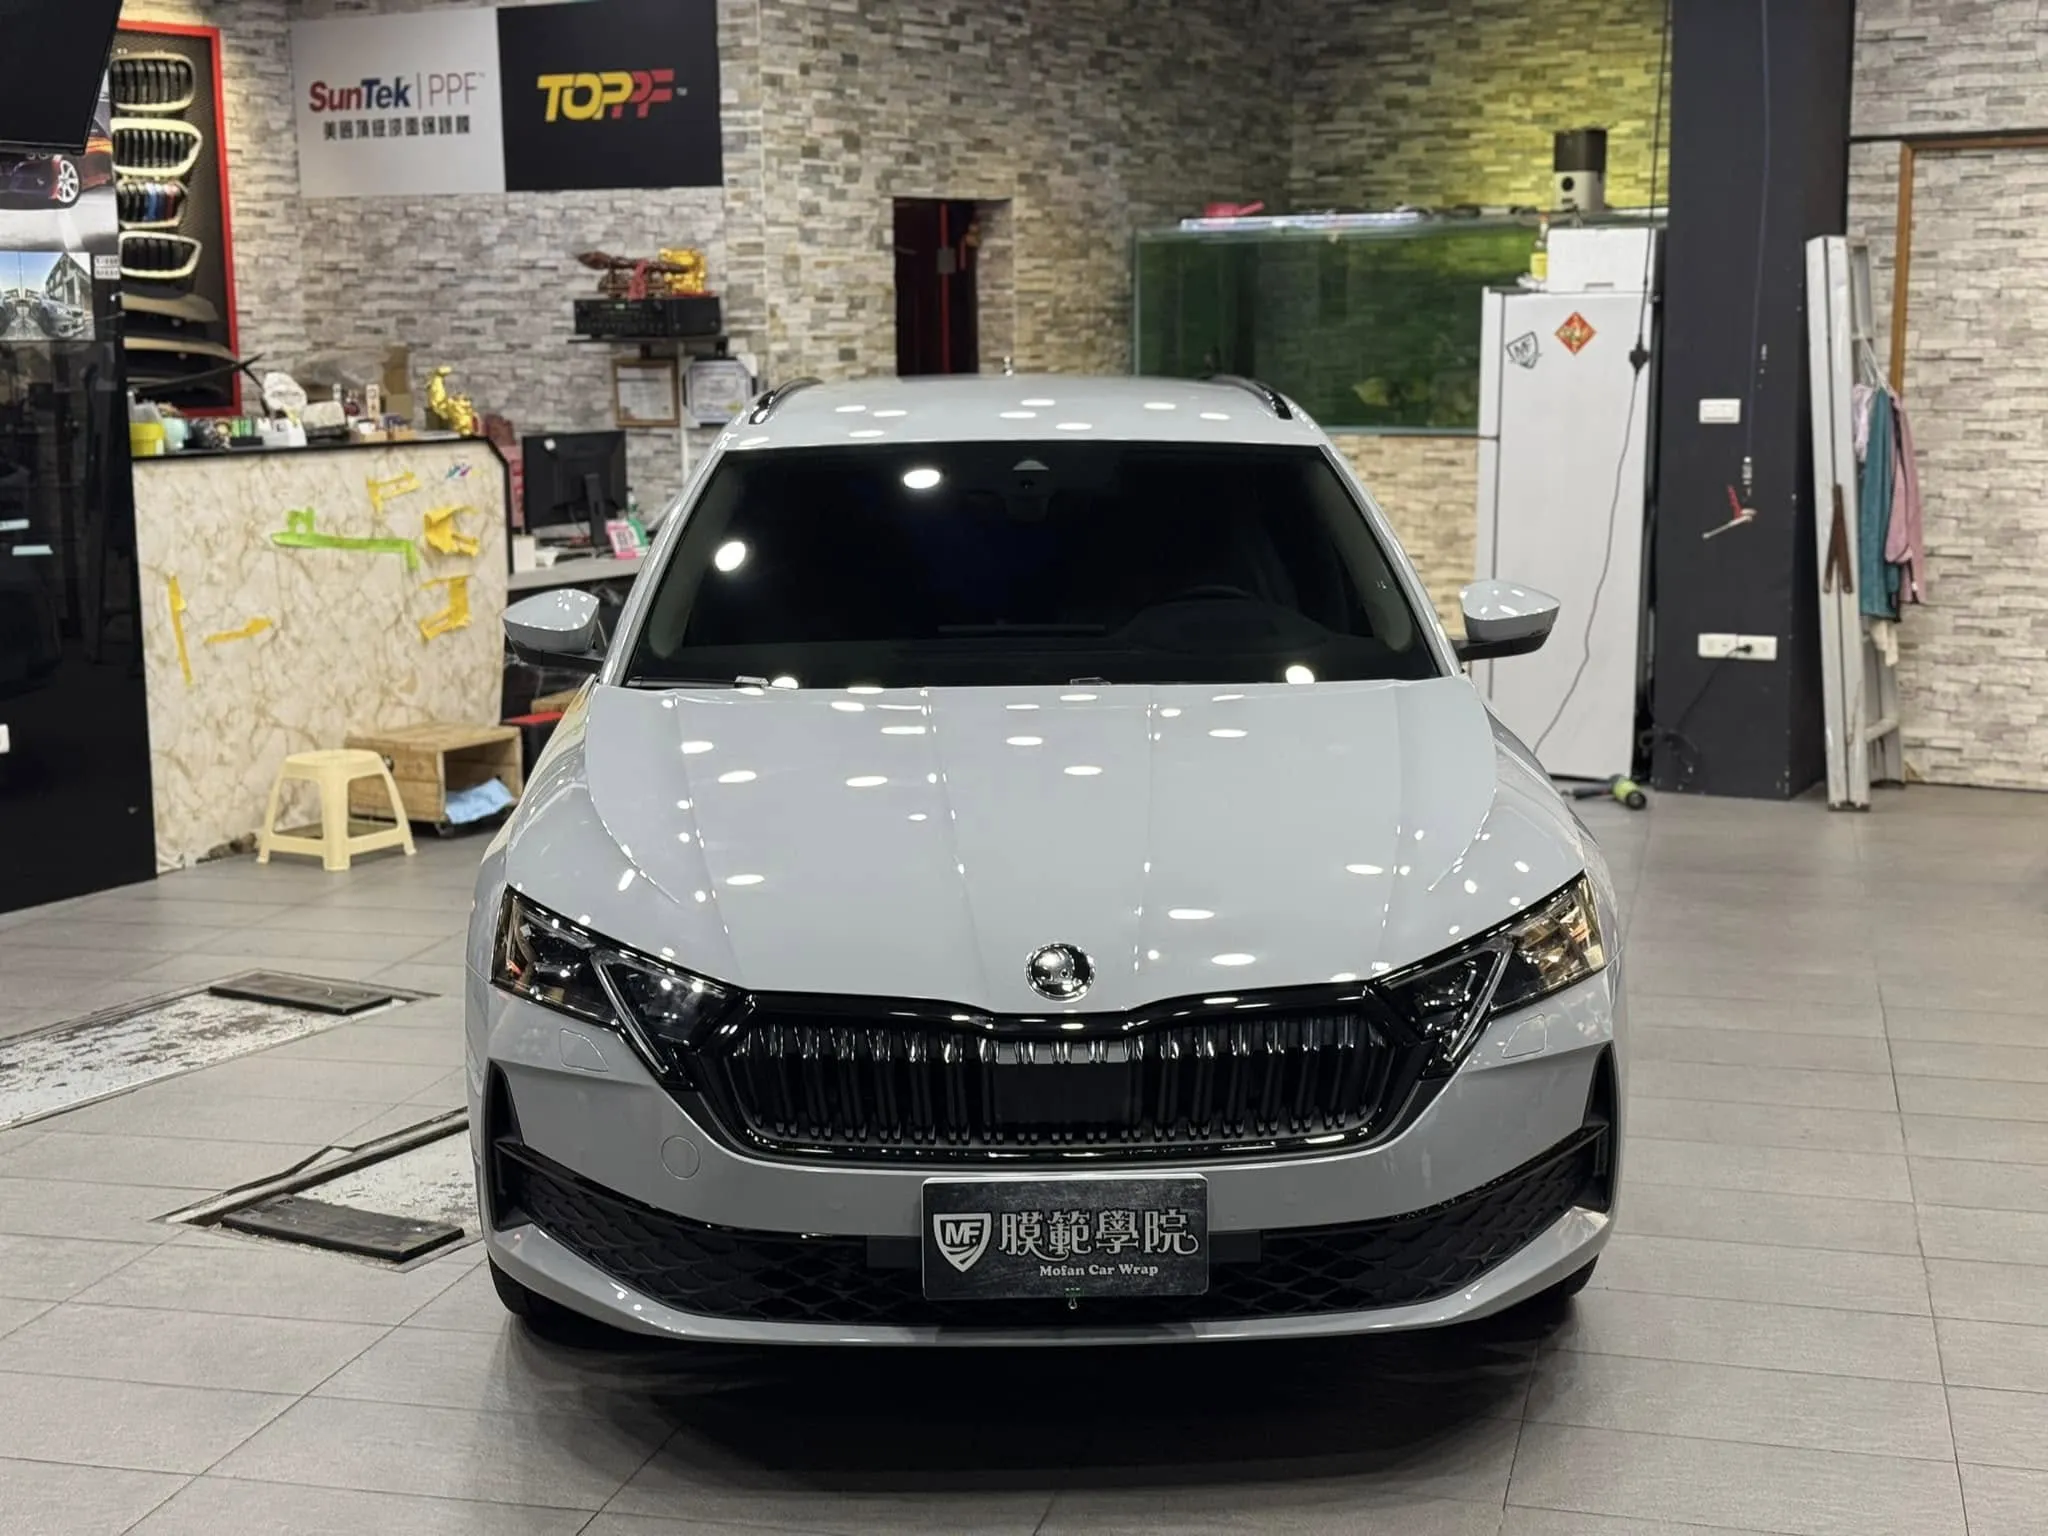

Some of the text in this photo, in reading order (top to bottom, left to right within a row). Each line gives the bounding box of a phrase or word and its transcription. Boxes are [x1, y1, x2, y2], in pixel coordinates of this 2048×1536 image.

[309, 72, 477, 112] SunTek PPF
[945, 1221, 982, 1245] MF
[998, 1208, 1200, 1262] 膜範學院
[1039, 1263, 1159, 1277] Mofan Car Wrap
